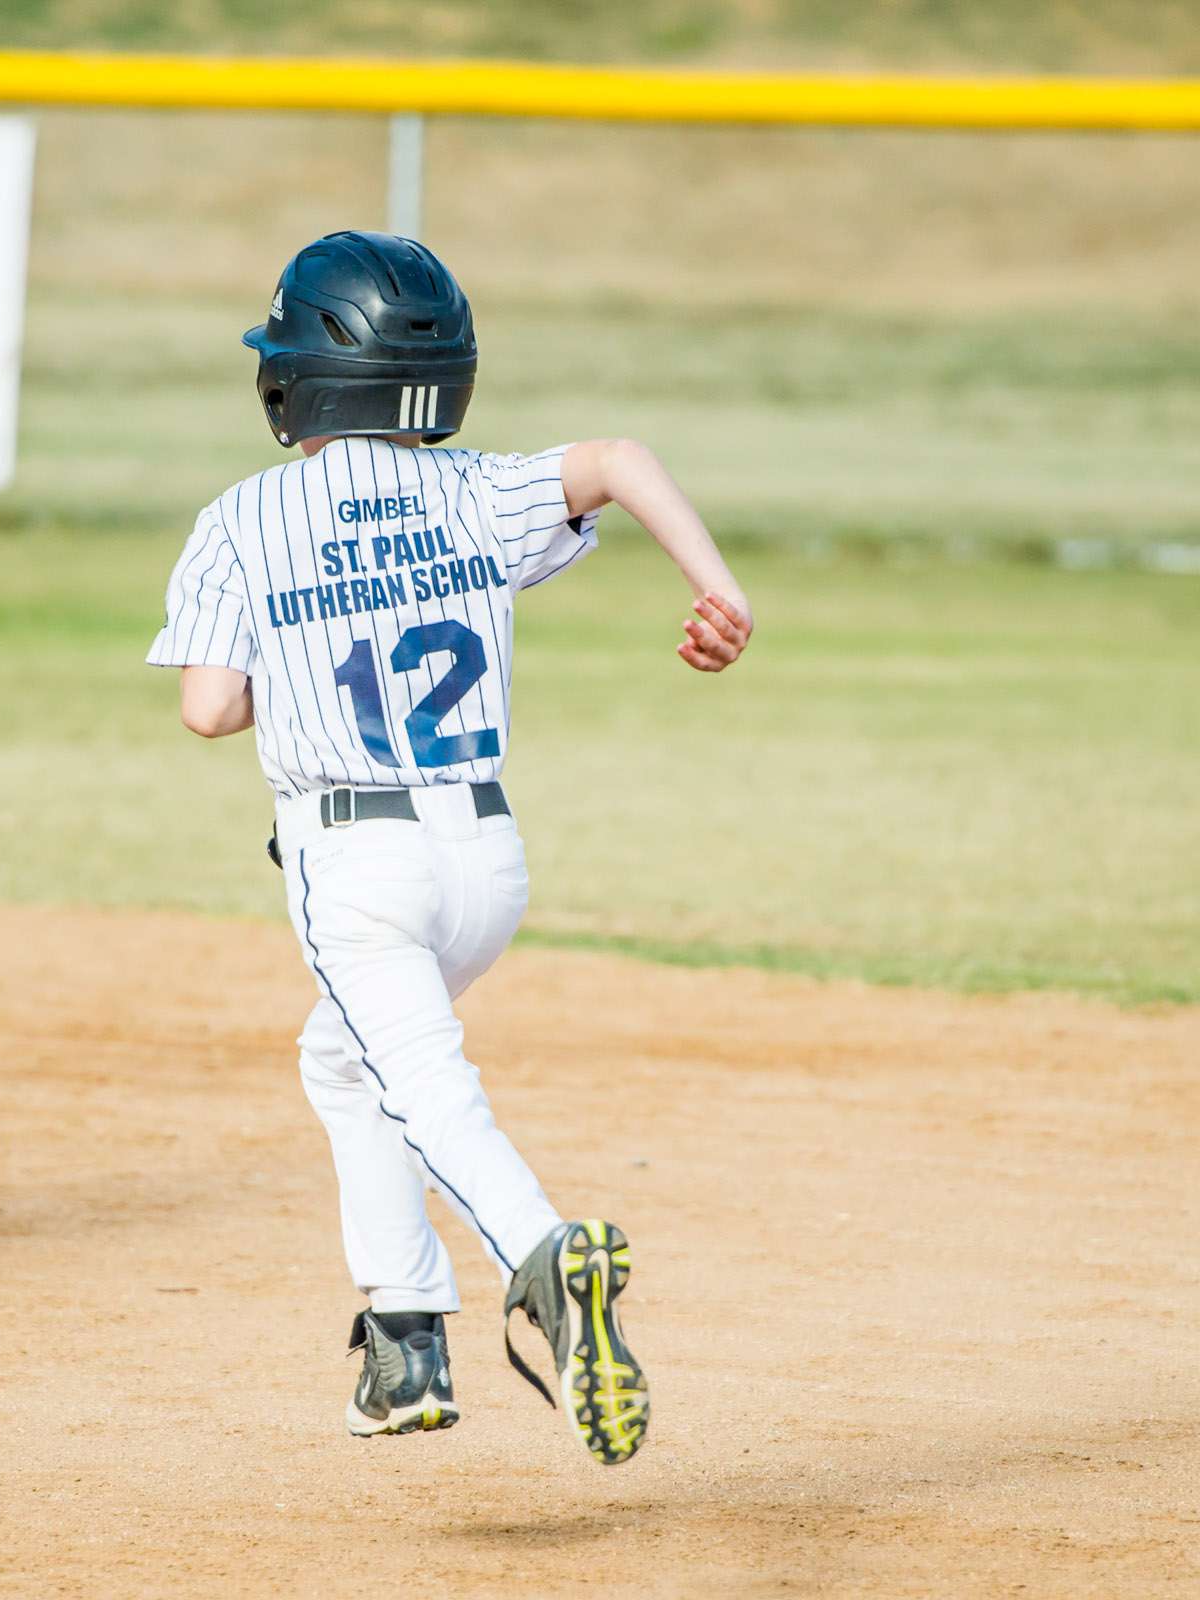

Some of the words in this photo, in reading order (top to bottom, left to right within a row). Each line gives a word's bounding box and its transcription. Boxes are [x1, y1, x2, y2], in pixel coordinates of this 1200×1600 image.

[338, 496, 426, 523] GIMBEL
[321, 540, 367, 577] ST.
[372, 526, 455, 570] PAUL
[266, 573, 408, 628] LUTHERAN
[334, 619, 500, 768] 12
